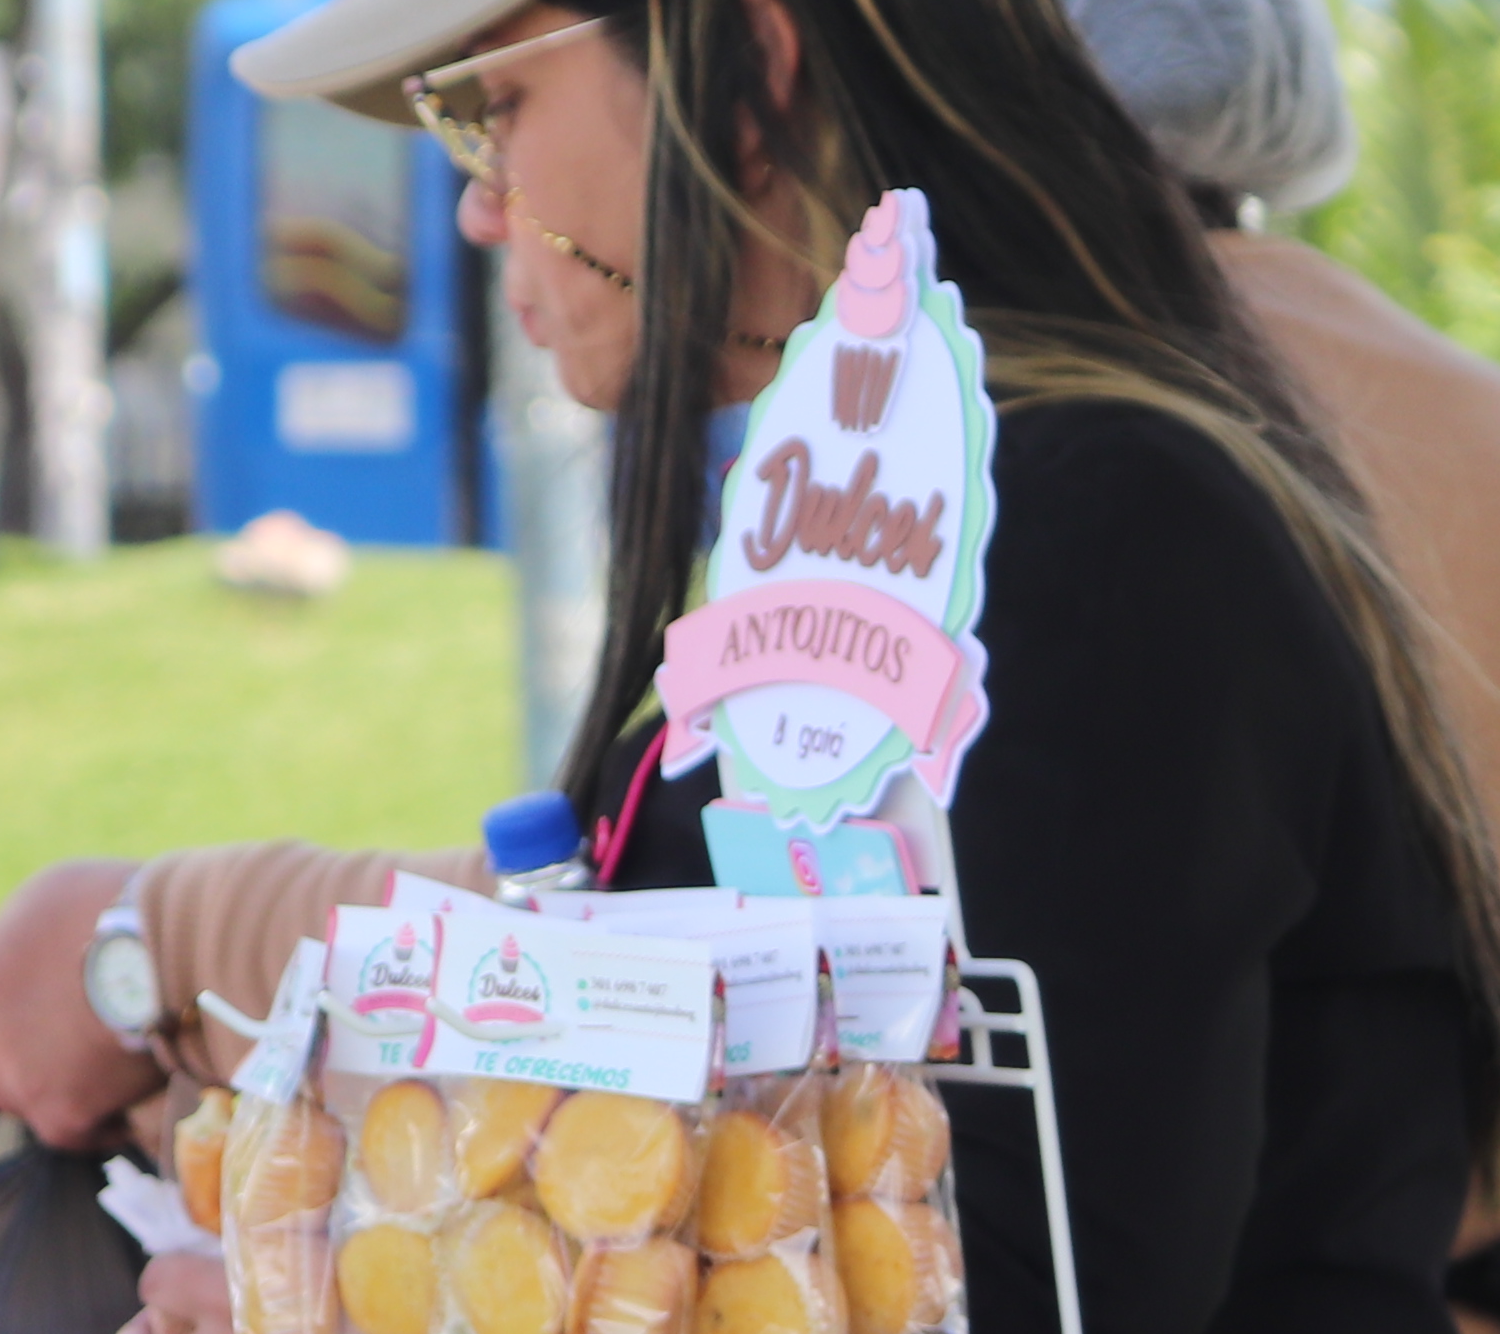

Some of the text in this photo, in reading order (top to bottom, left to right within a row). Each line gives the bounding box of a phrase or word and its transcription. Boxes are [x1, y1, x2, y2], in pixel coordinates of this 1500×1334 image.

[742, 435, 943, 578] Dulces
[721, 606, 910, 683] ANTOJITOS
[478, 972, 542, 1002] Dulces
[475, 1051, 632, 1089] TE OFRECEMOS
